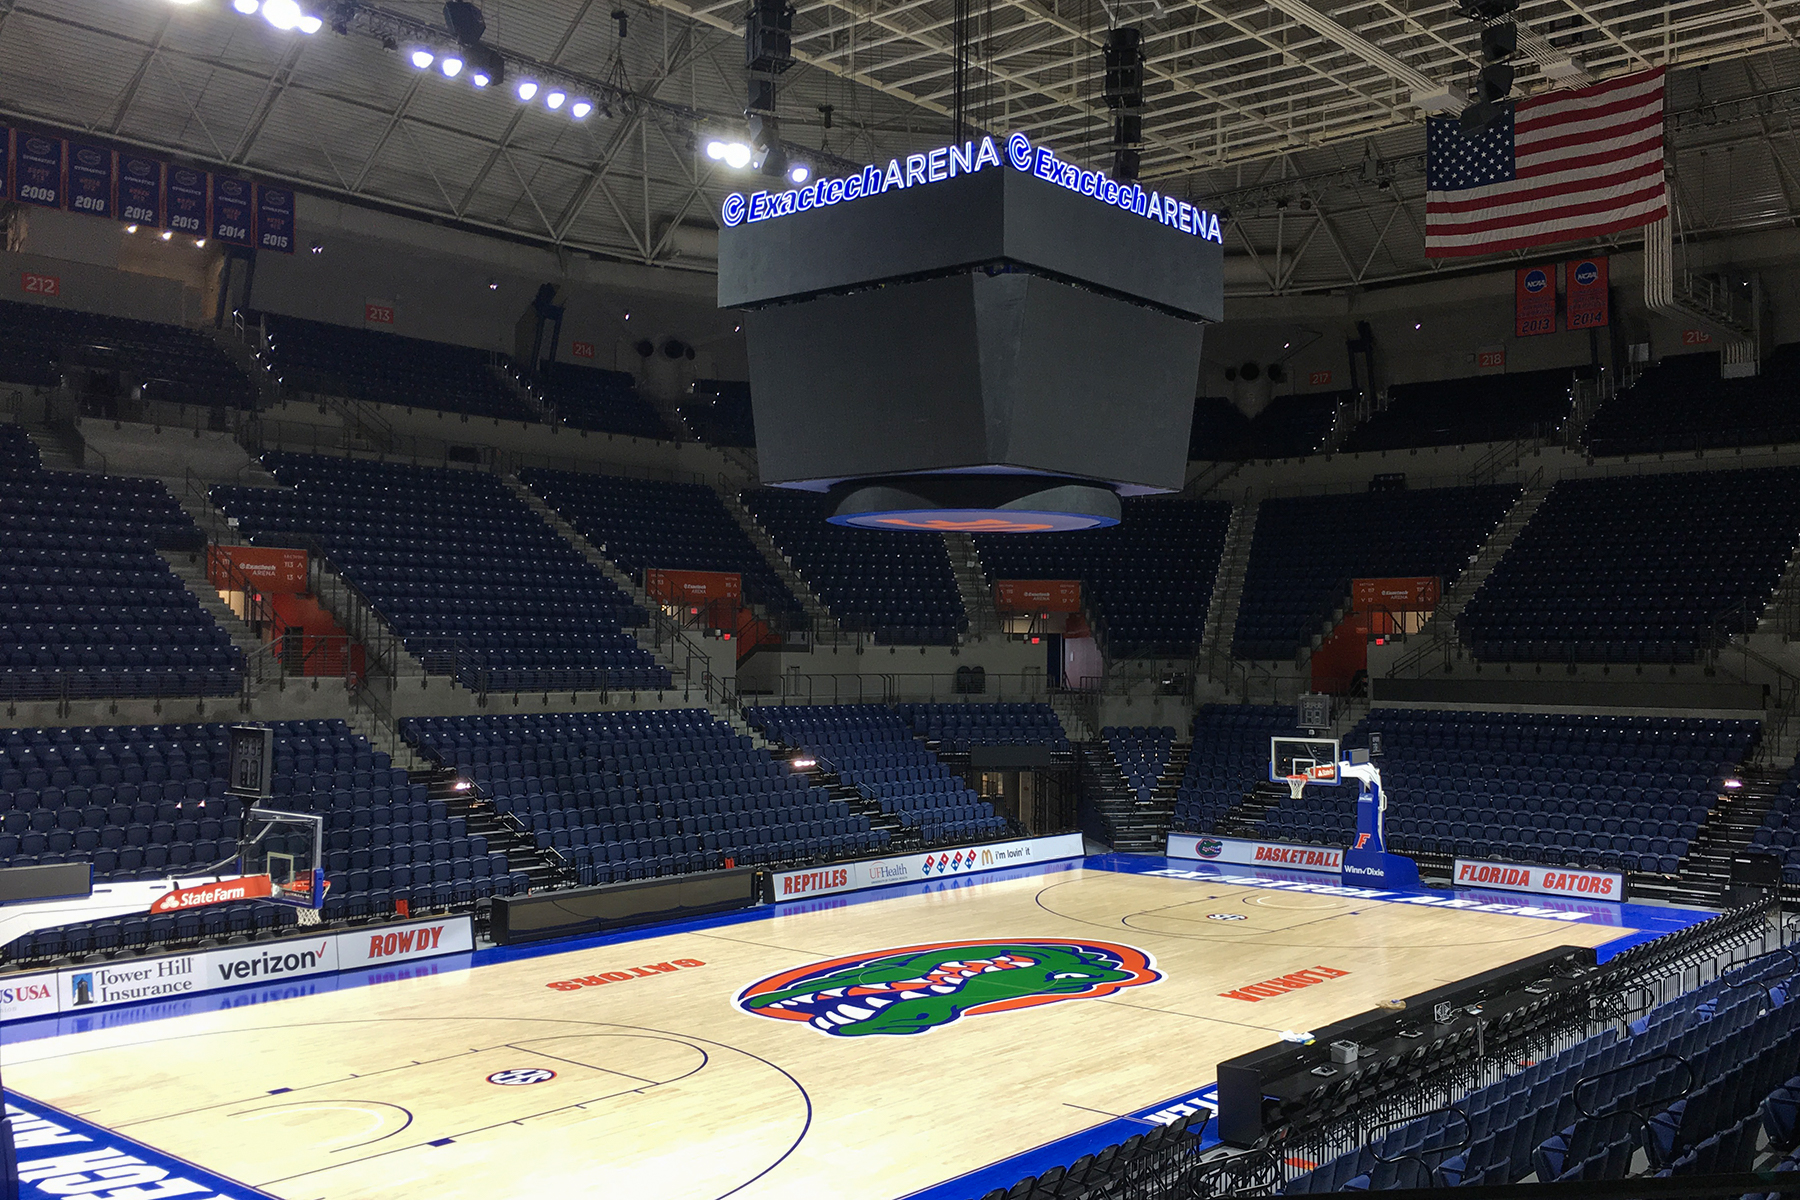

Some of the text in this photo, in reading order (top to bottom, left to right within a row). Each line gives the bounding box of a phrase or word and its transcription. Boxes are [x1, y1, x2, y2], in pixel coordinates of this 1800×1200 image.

[21, 185, 56, 202] 2009
[75, 196, 105, 211] 2010
[124, 206, 153, 222] 2012
[171, 215, 199, 230] 2013
[218, 224, 246, 239] 2014
[263, 233, 288, 248] 2015
[26, 276, 54, 293] 212
[370, 307, 390, 321] 213
[1573, 312, 1602, 326] 2014
[1522, 318, 1549, 333] 2013
[574, 344, 592, 356] 214
[1482, 353, 1502, 366] 218
[1311, 372, 1328, 384] 217
[1355, 833, 1371, 849] F
[1025, 847, 1031, 856] it
[1255, 846, 1340, 868] BASKETBALL
[783, 868, 847, 895] REPTILES
[1459, 864, 1613, 894] FLORIDA GATORS
[1138, 868, 1594, 921] EXACTECH ARENA
[368, 926, 444, 959] ROWDY
[96, 957, 192, 986] Tower Hill
[218, 951, 316, 981] verizon
[545, 958, 706, 992] GATORS
[101, 980, 192, 1003] Insurance
[1218, 965, 1352, 1003] FLORIDA
[15, 984, 51, 1002] USA
